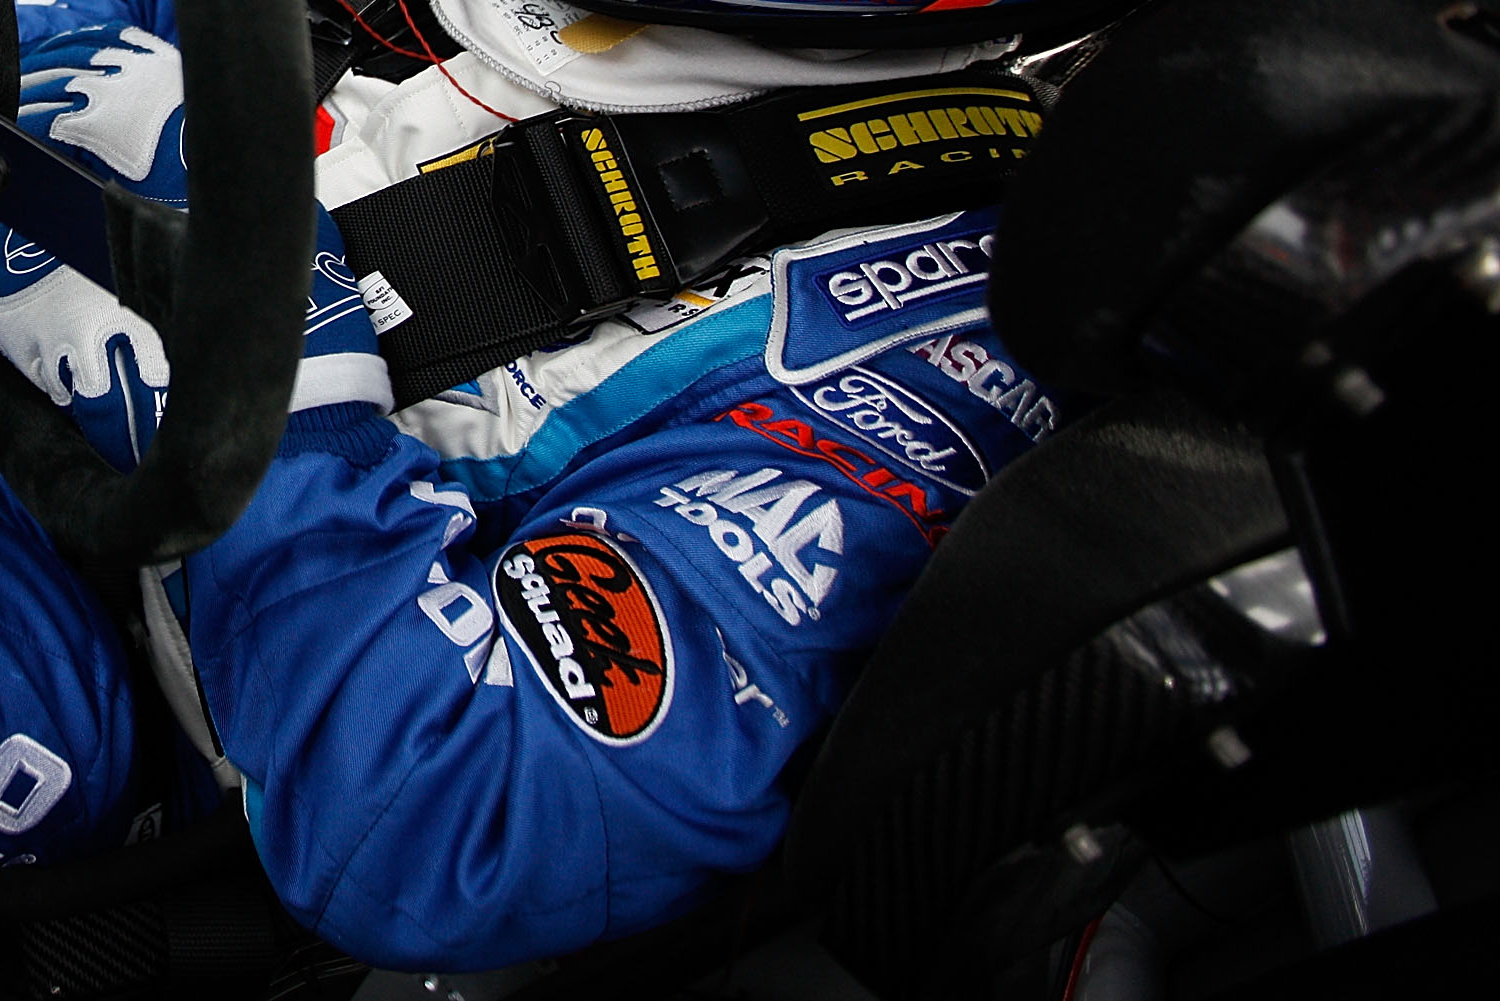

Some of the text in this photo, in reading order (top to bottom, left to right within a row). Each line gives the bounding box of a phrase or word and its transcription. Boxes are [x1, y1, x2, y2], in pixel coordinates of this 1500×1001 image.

[581, 128, 660, 280] SCHROTH
[814, 375, 958, 472] Ford
[652, 487, 807, 626] TOOLS
[673, 468, 844, 607] MAC
[533, 545, 664, 689] Geek
